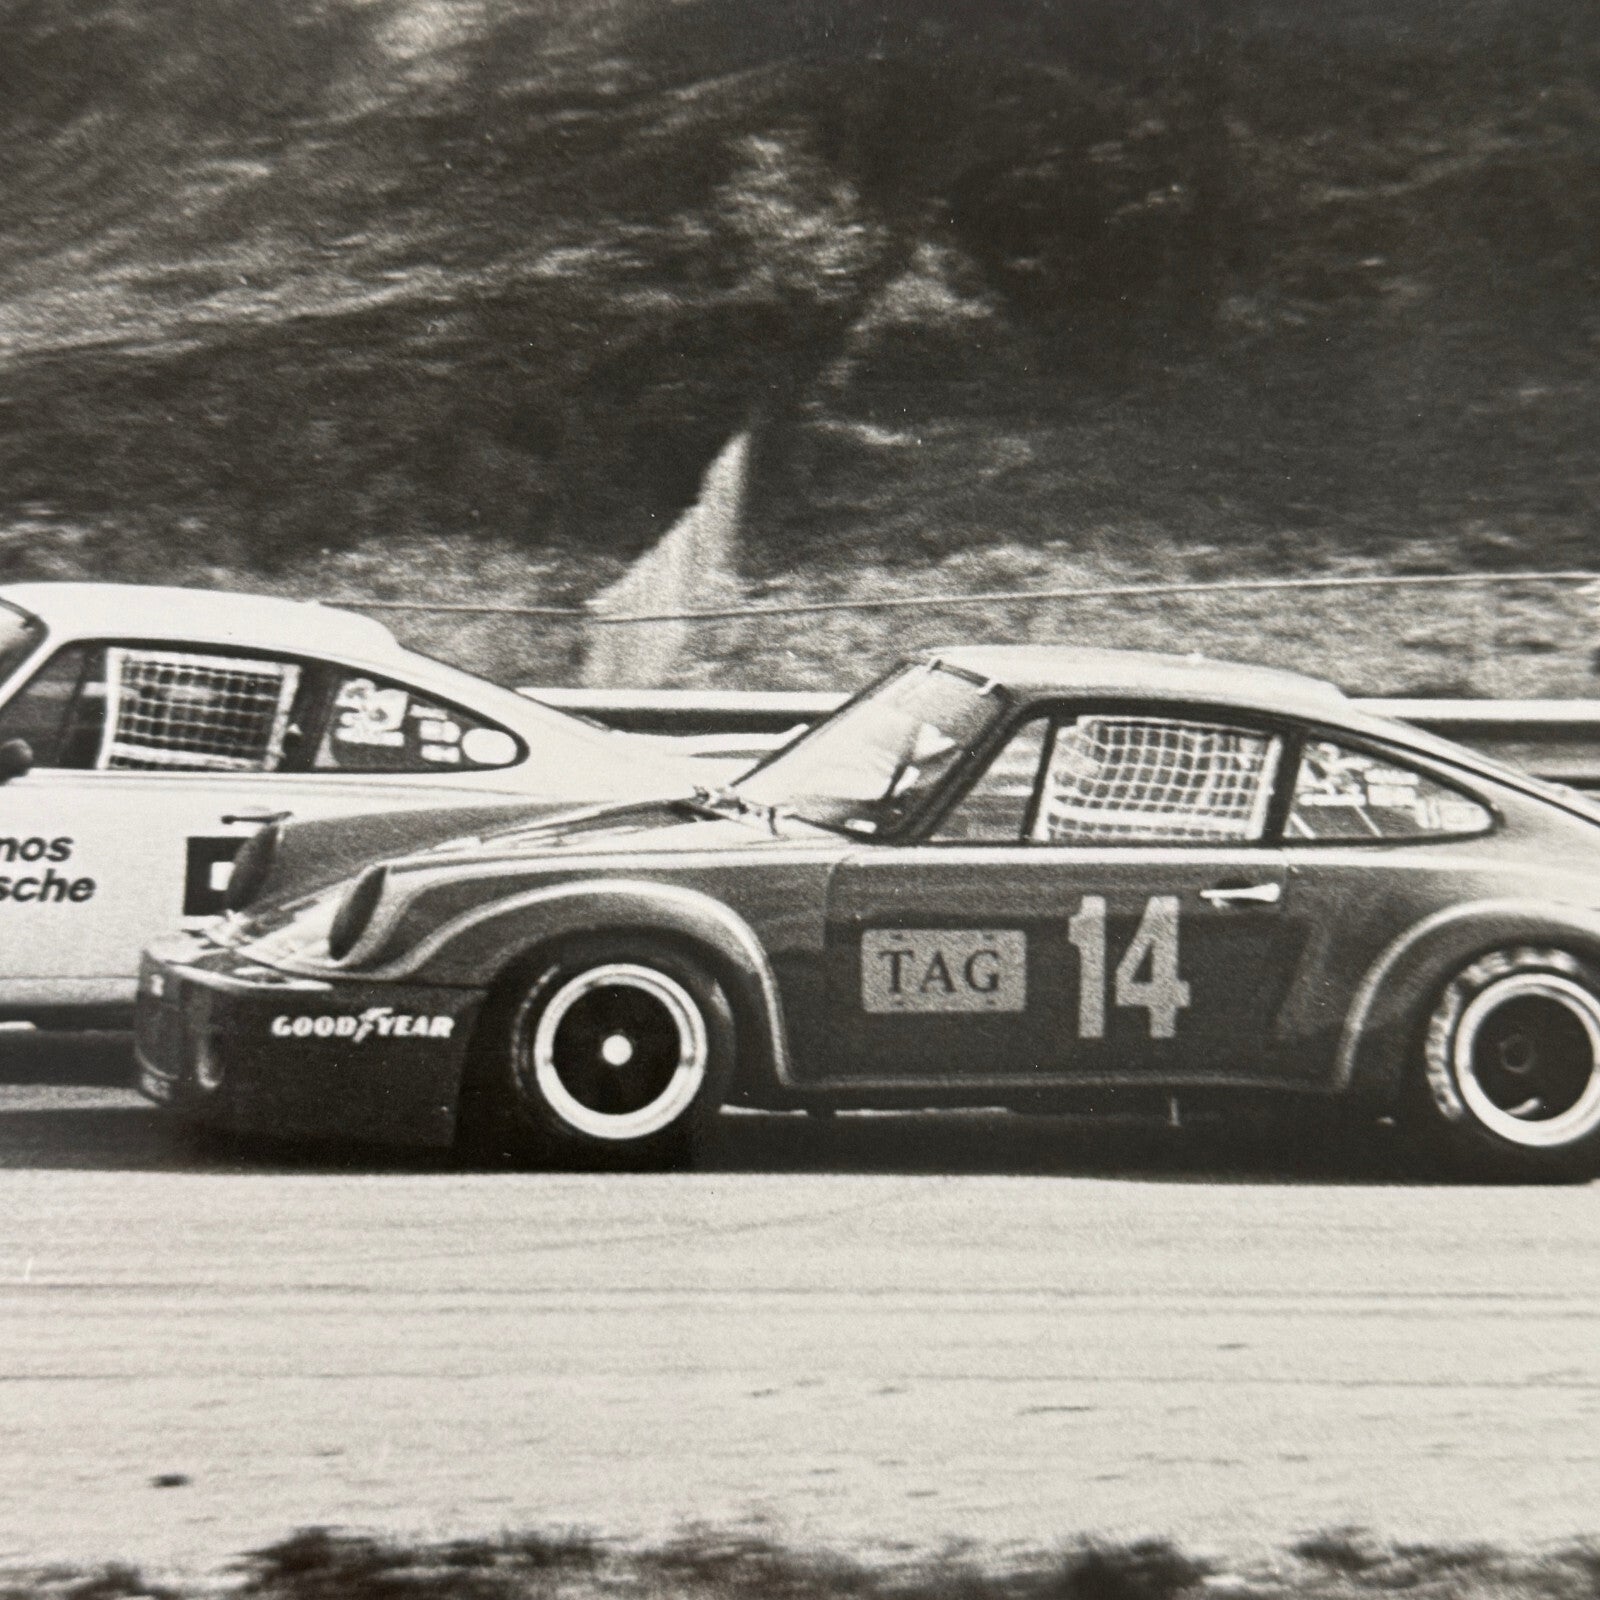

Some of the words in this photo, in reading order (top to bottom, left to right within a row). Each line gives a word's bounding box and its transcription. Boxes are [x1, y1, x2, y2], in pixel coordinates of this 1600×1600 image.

[879, 949, 1000, 994] TAG
[1068, 895, 1190, 1038] 14
[271, 1006, 455, 1044] GOODYEAR
